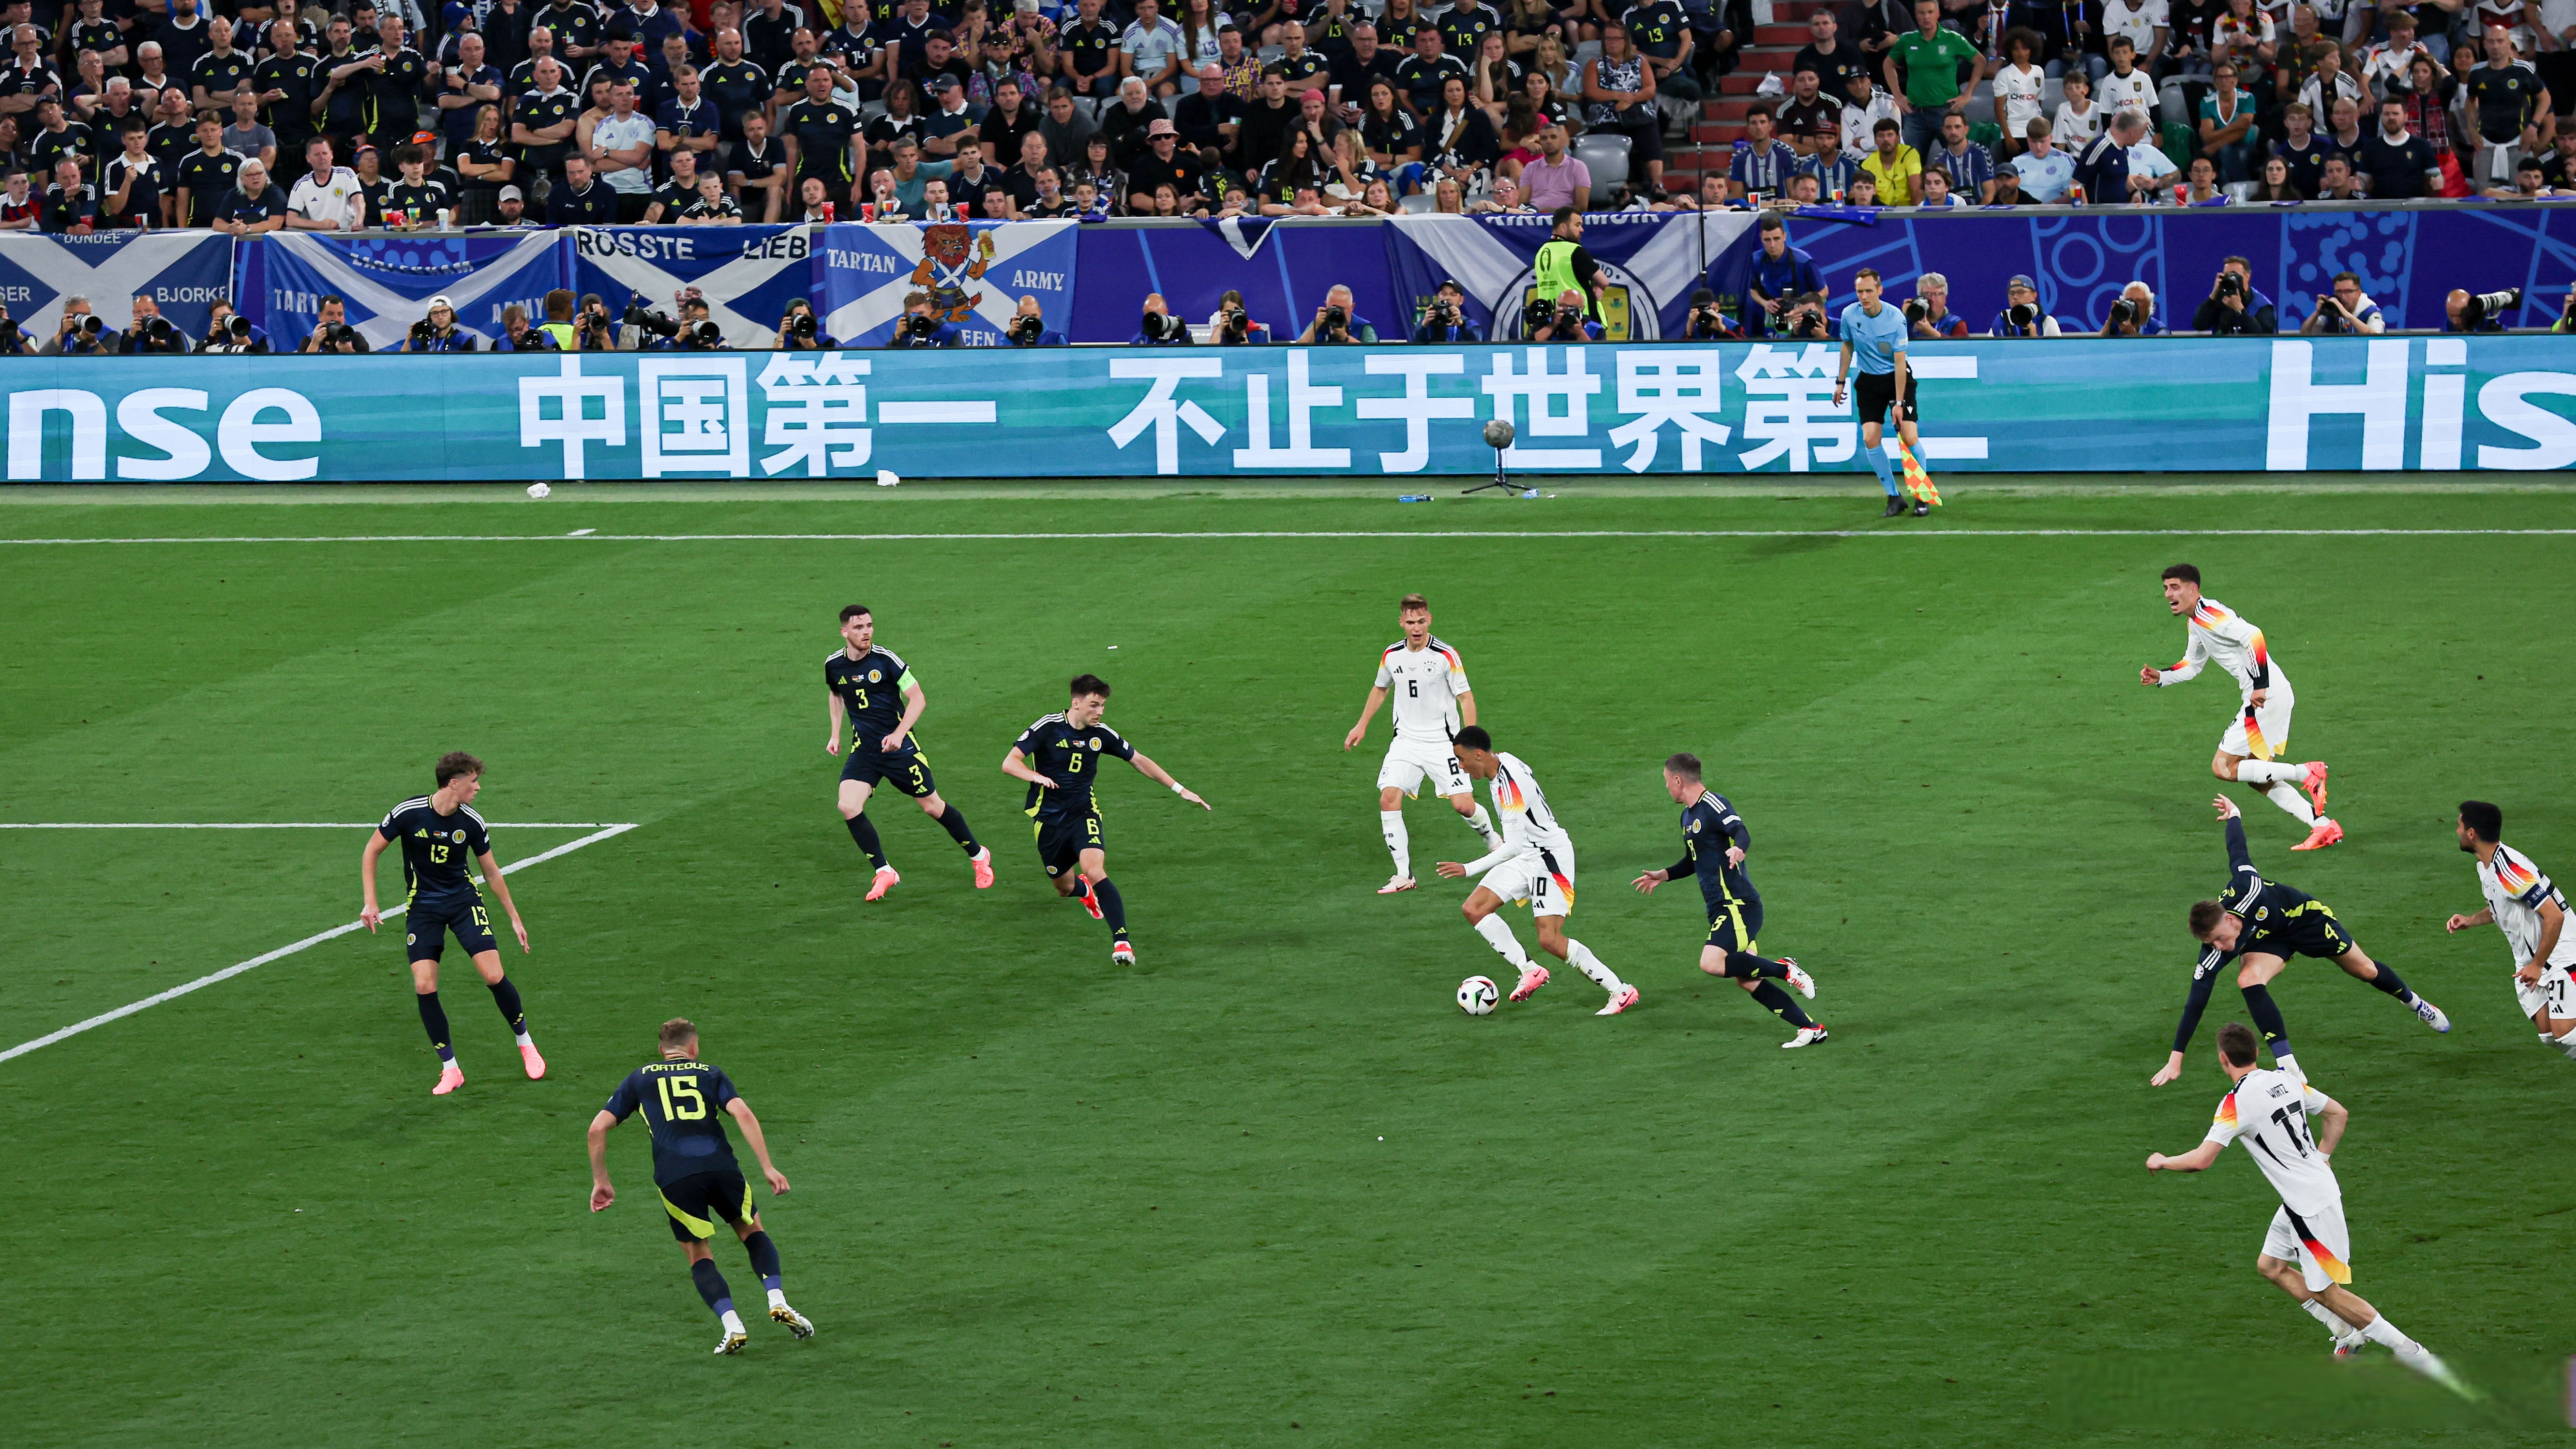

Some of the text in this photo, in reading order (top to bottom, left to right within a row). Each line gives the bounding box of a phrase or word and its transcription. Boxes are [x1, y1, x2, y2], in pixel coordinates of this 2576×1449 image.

[1458, 33, 1472, 46] 13
[1648, 27, 1664, 43] 13
[852, 50, 866, 64] 14
[577, 228, 807, 260] RÖSSTE LIEB
[827, 248, 1064, 291] TARTAN ARMY
[519, 344, 1988, 479] 中国第一 不止于世界第二
[8, 388, 322, 481] nse
[855, 688, 869, 709] 3
[1408, 679, 1418, 698] 6
[1068, 752, 1083, 773] 6
[1447, 757, 1459, 775] 6
[908, 764, 924, 785] 3
[1086, 818, 1100, 835] 6
[431, 844, 449, 864] 13
[471, 906, 490, 926] 13
[2325, 922, 2339, 940] 4
[642, 1062, 710, 1075] PORTEOUS
[657, 1075, 707, 1122] 15
[2266, 1083, 2289, 1099] WIRTZ
[2270, 1100, 2316, 1159] 17
